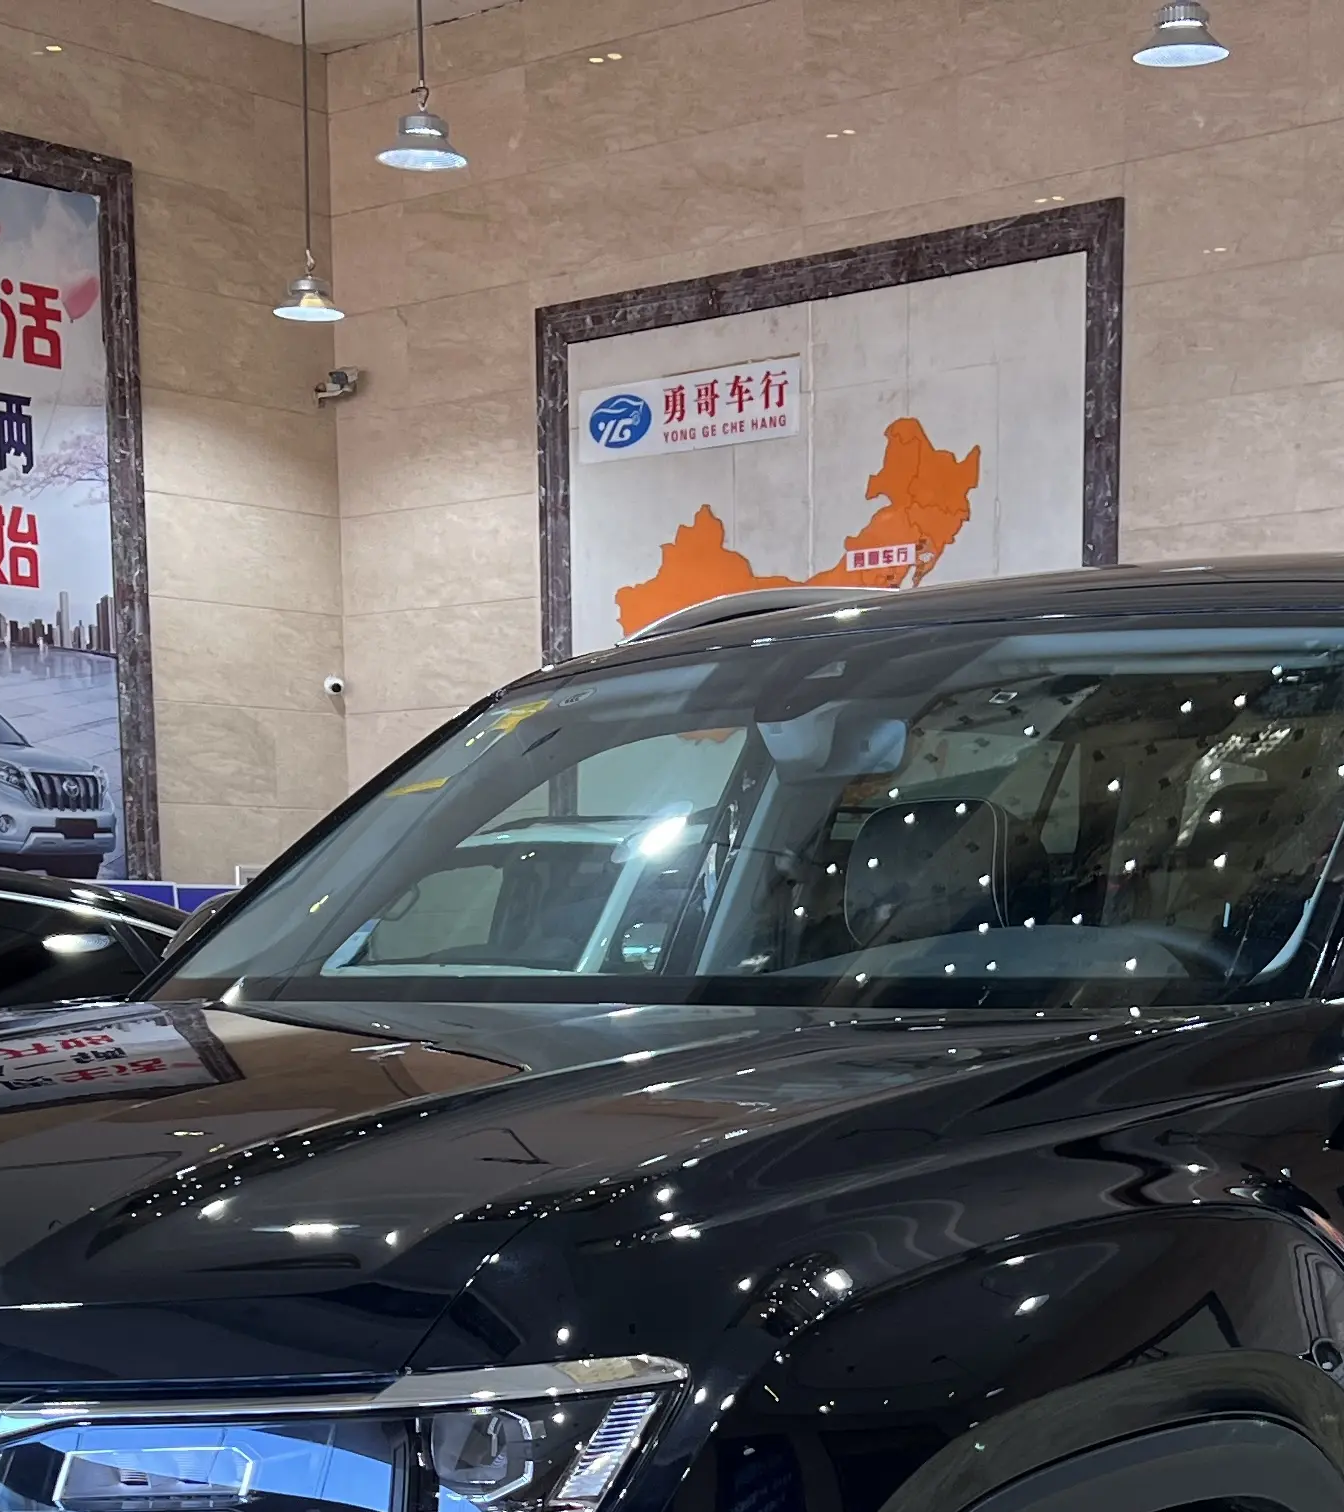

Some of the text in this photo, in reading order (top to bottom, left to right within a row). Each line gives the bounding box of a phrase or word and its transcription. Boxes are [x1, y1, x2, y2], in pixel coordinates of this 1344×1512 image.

[663, 370, 789, 425] 勇哥车行
[663, 414, 787, 444] YONG GE CHE HANG
